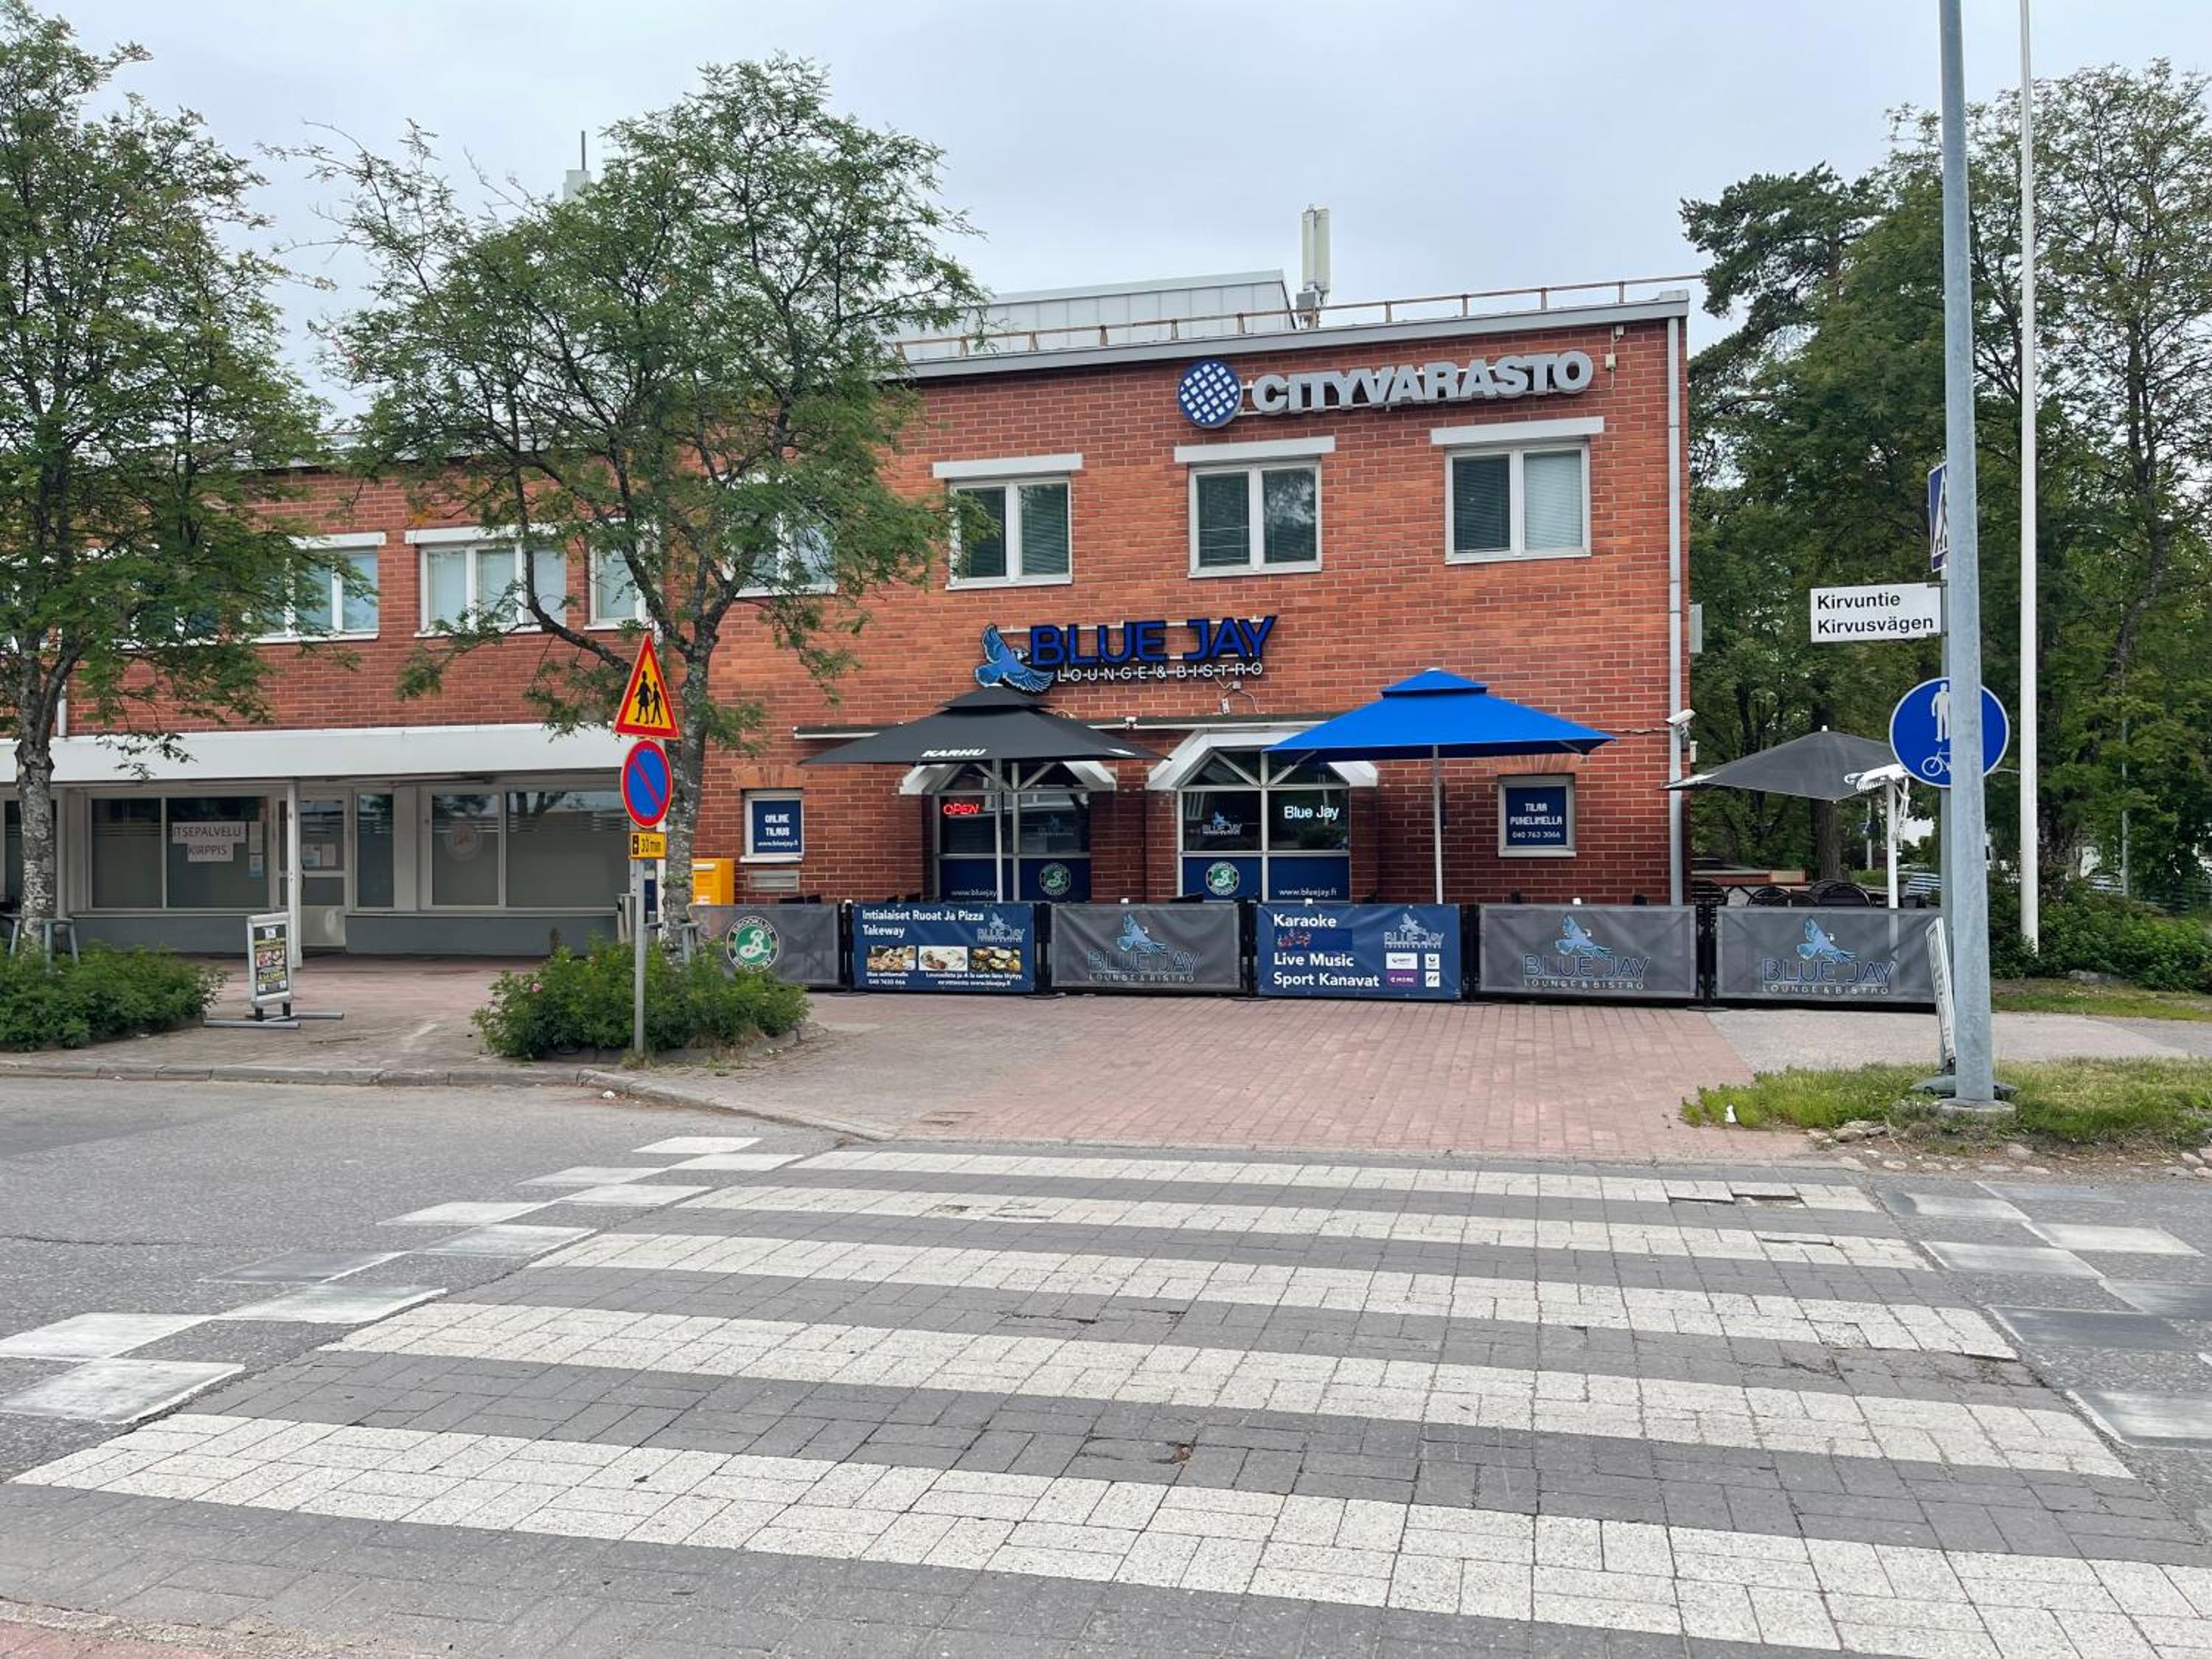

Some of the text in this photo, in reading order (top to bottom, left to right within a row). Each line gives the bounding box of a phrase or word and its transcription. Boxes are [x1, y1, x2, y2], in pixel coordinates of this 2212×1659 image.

[1253, 350, 1593, 414] CITYVARASTO
[1818, 592, 1900, 610] Kirvuntie
[1818, 616, 1933, 634] Kirvusvägen
[1030, 615, 1278, 664] BLUE JAY
[1057, 662, 1263, 683] LOUNGE & BISTRO
[921, 748, 987, 757] KARHU
[943, 802, 980, 815] OPEN
[1284, 804, 1340, 821] Blue Jay
[1524, 802, 1548, 812] TILAA
[173, 826, 242, 838] ITSEPALVELU
[188, 844, 228, 857] KIRPPIS
[1279, 887, 1337, 897] www.bluejay.fi
[862, 909, 984, 921] Intialaiset Ruoat Ja Pizza
[1273, 914, 1337, 928] Karaoke
[862, 924, 905, 939] Takeway
[1086, 950, 1200, 975] BLUE JAY
[1273, 953, 1354, 967] Live Music
[1523, 953, 1651, 980] BLUE JAY
[1762, 959, 1896, 984] BLUE JAY
[1273, 972, 1380, 989] Sport Kanavat
[1523, 978, 1576, 987] LOUNGE
[1593, 981, 1644, 990] BISTRO
[1763, 985, 1818, 994] LOUNGE
[1835, 987, 1888, 995] BISTRO
